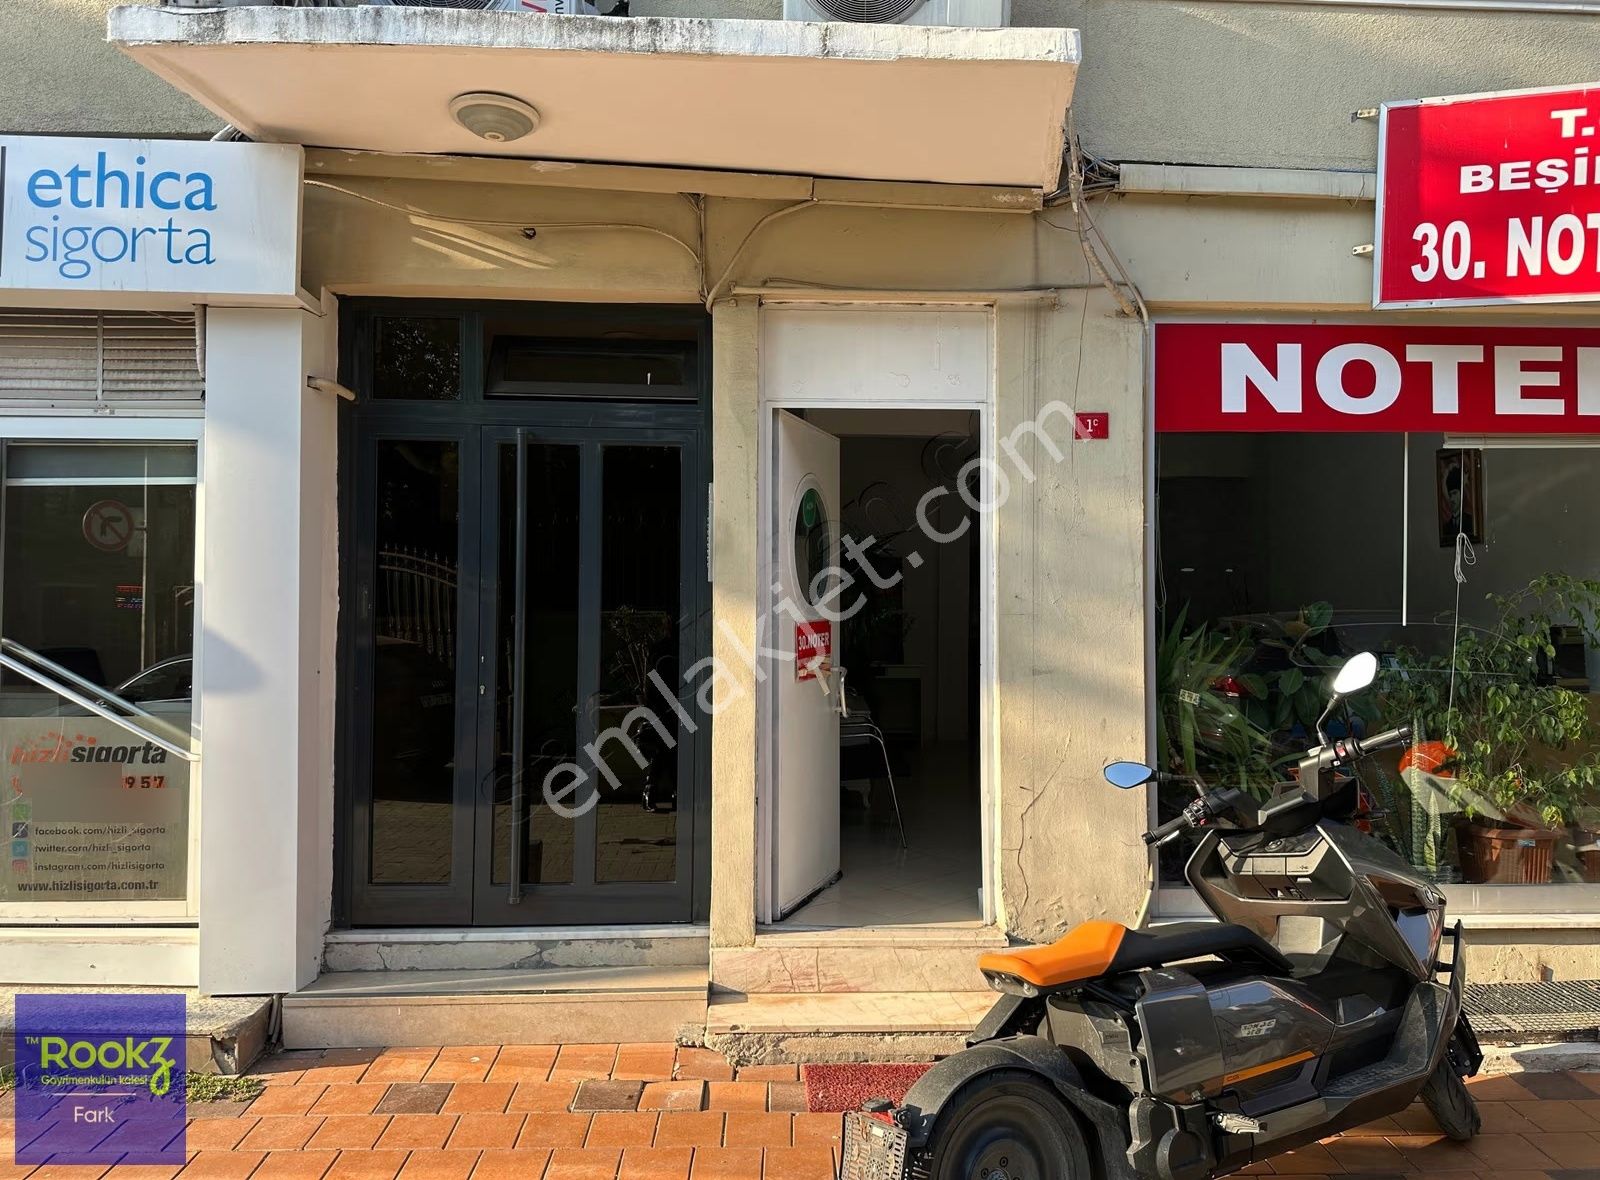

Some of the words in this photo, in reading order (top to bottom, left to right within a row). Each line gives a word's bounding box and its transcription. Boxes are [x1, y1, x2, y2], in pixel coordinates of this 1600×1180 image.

[27, 151, 217, 211] ethica
[1459, 146, 1600, 194] BEŞİ
[25, 214, 216, 279] sigorta
[1410, 220, 1486, 283] 30.
[17, 879, 160, 893] www.hizlisigorta.com.tr
